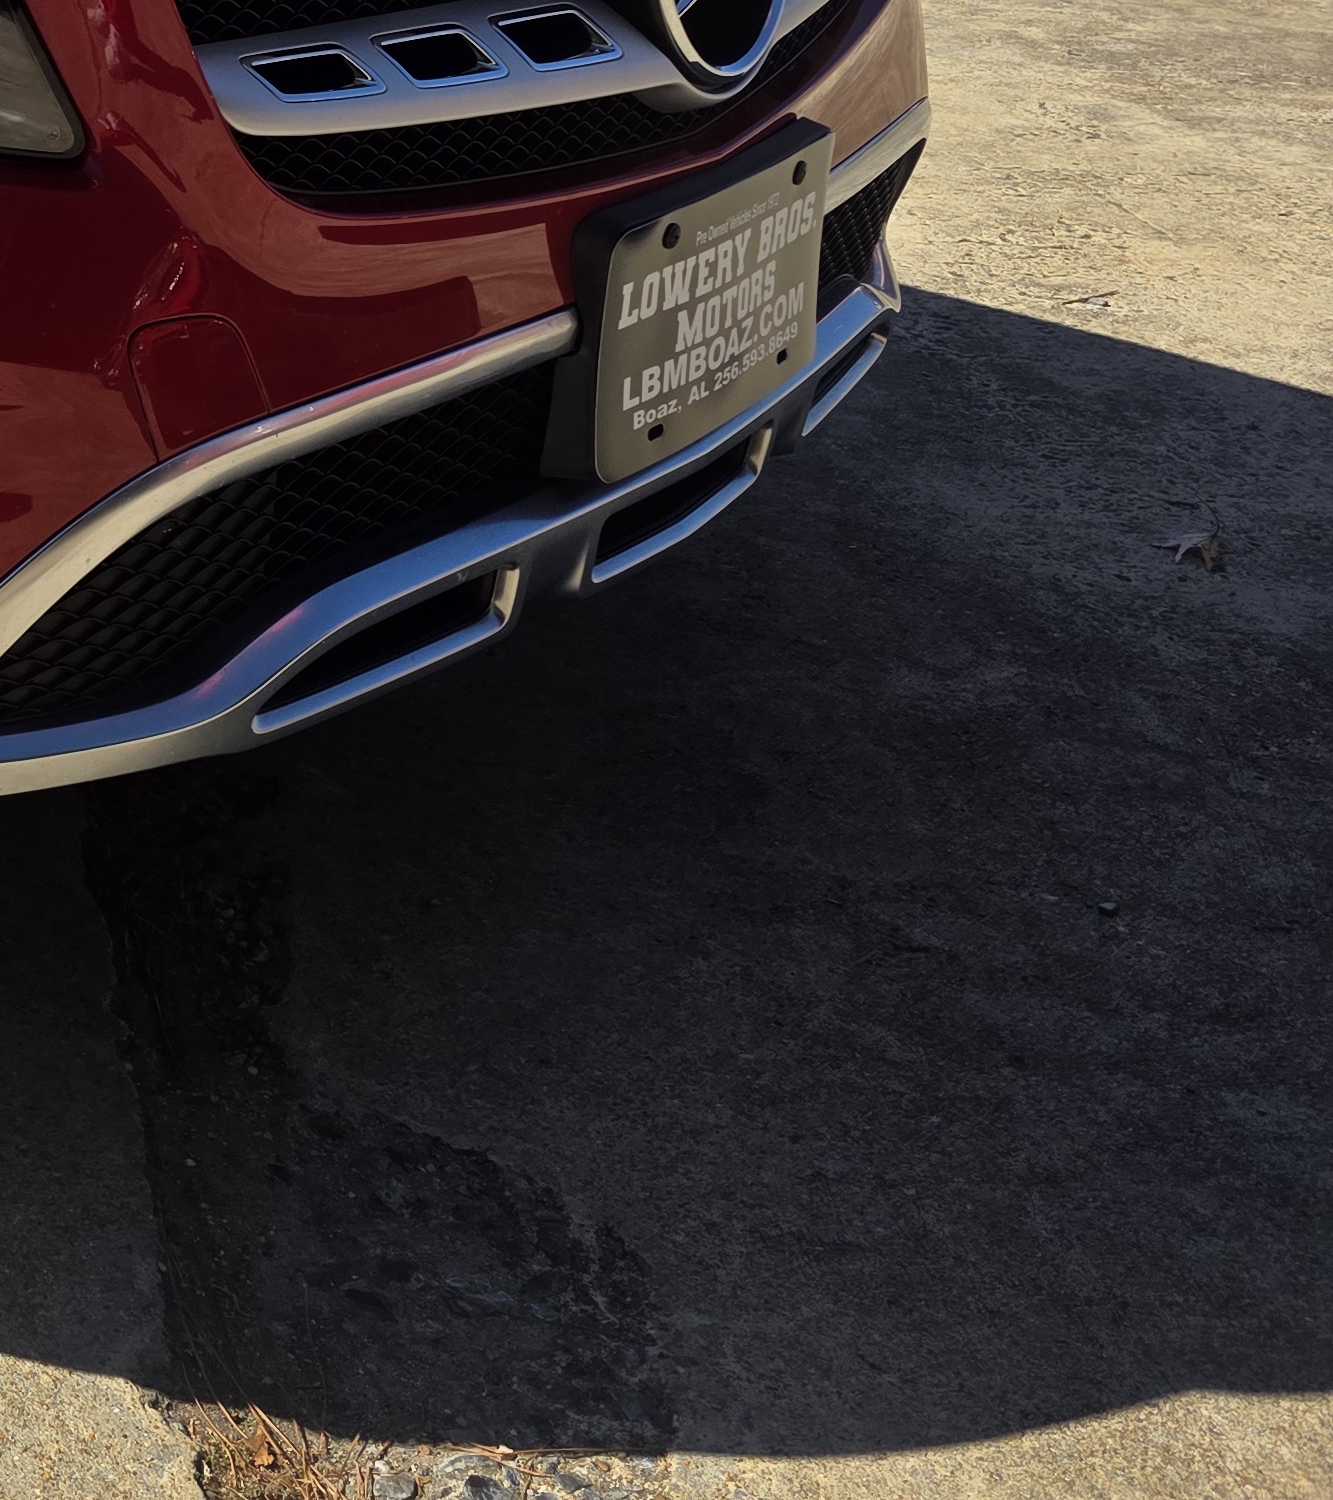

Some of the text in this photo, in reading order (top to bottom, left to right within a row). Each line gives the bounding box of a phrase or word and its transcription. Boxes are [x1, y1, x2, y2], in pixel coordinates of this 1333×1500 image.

[618, 191, 817, 330] LOWERY BROS.
[675, 259, 777, 353] MOTORS
[623, 281, 806, 411] LBMBOAZ.COM
[633, 321, 799, 431] Boaz, AL 256.593.8649
